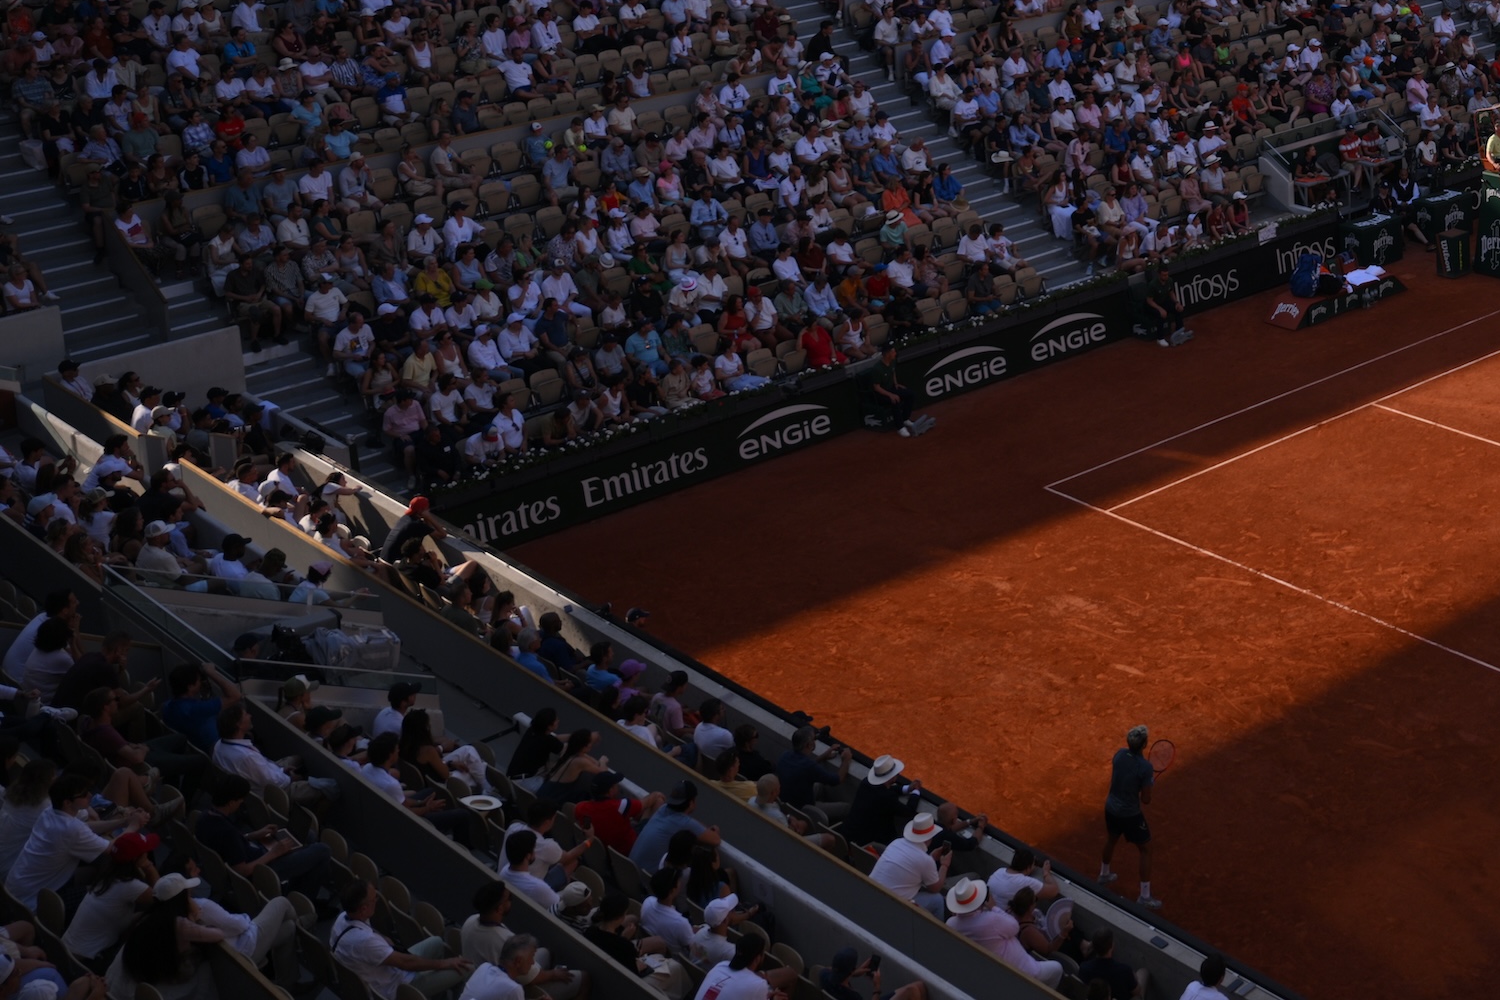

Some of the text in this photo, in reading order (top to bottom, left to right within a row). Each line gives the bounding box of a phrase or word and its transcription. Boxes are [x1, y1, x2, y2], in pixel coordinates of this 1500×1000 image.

[1174, 269, 1240, 308] Infosys
[581, 447, 709, 508] Emirates
[463, 495, 562, 544] irates
